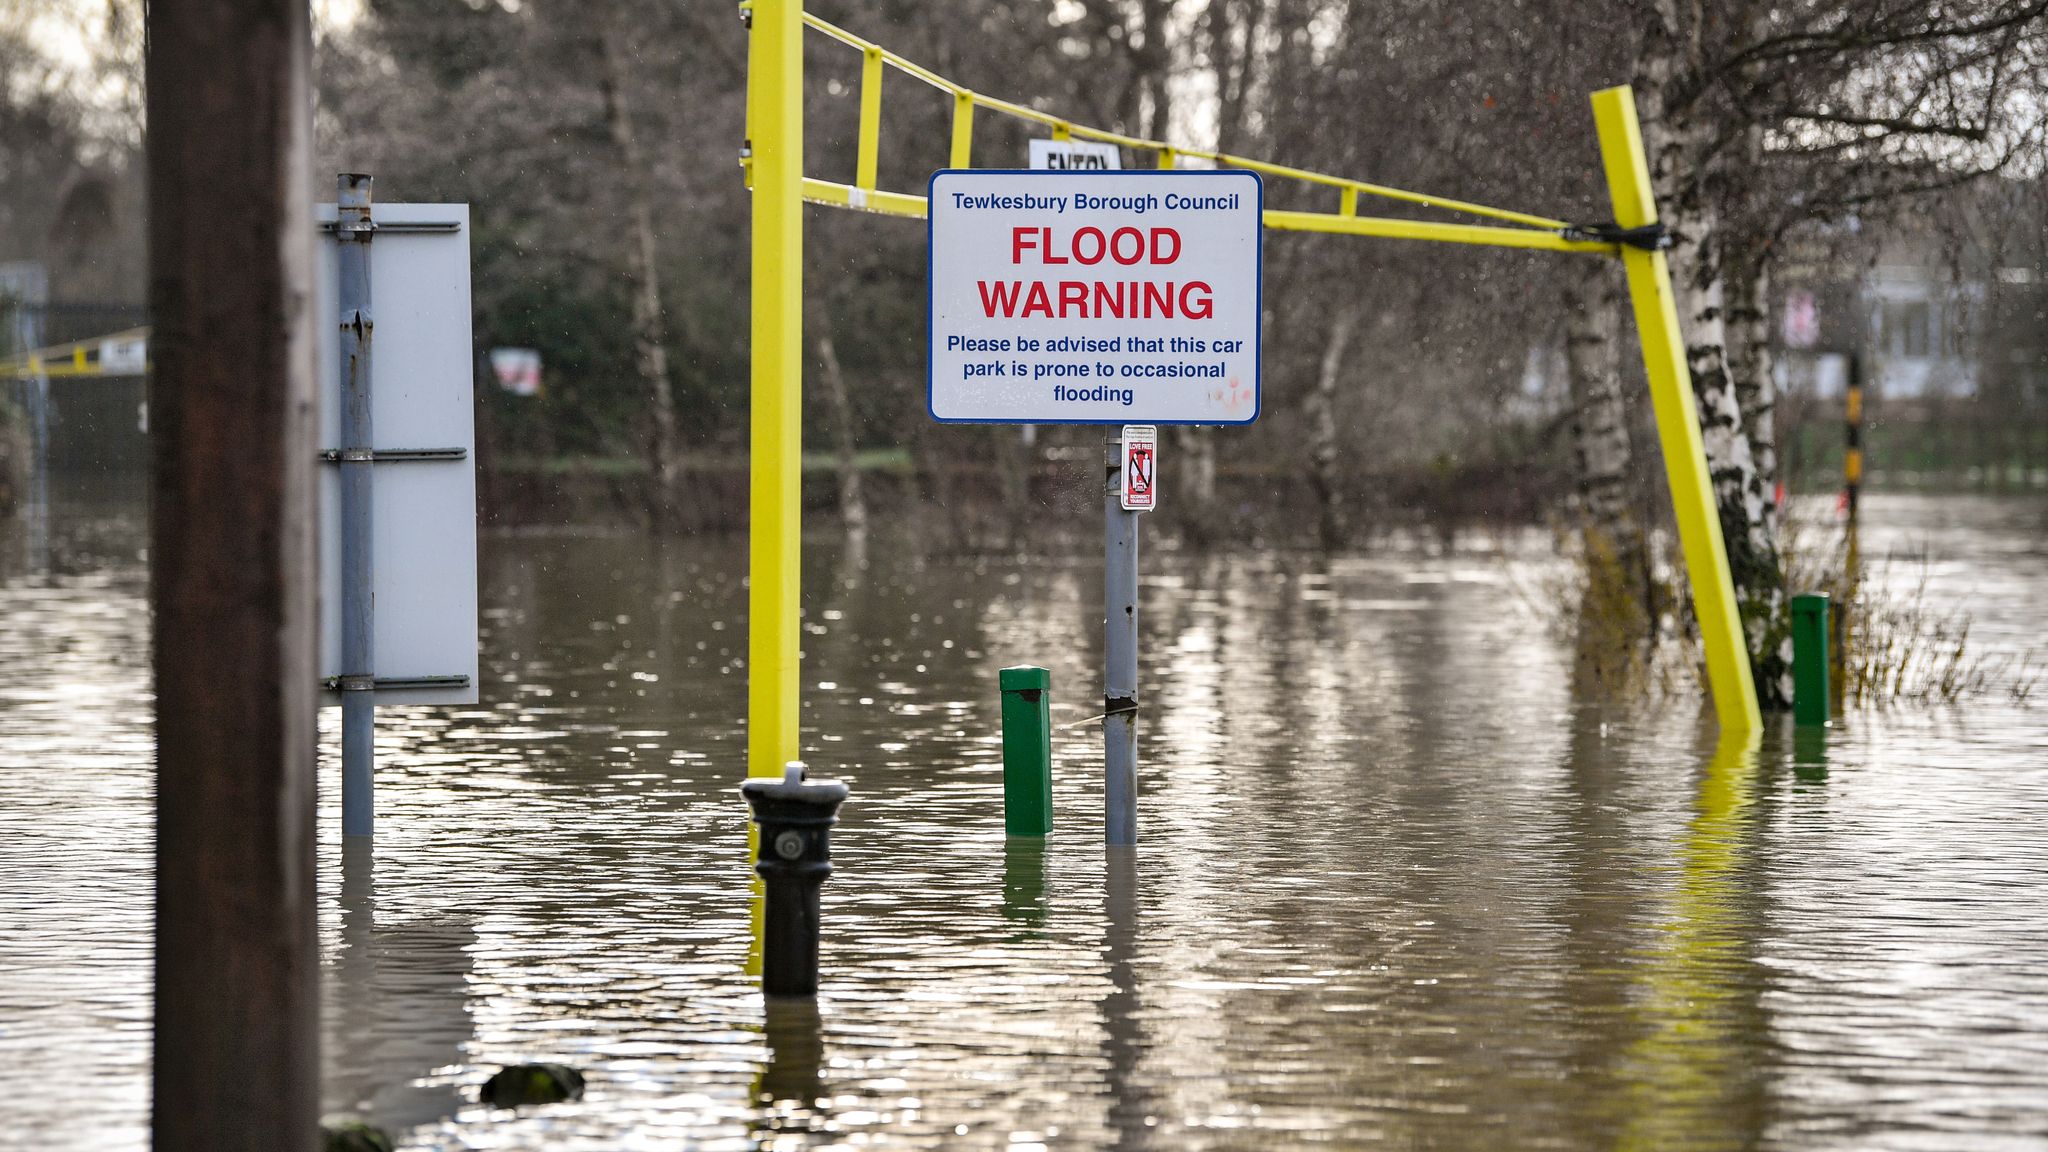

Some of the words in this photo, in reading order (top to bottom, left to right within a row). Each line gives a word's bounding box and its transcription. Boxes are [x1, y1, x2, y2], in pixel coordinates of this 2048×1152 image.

[952, 193, 1067, 214] Tewkesbury
[1075, 193, 1158, 214] Borough
[1165, 193, 1239, 210] Council
[1012, 226, 1182, 266] FLOOD
[977, 280, 1214, 320] WARNING
[948, 335, 1011, 352] Please
[1018, 335, 1040, 352] be
[1046, 336, 1121, 353] advised
[1127, 336, 1165, 353] that
[1170, 336, 1206, 353] this
[1213, 340, 1243, 353] car
[963, 360, 1006, 380] park
[1012, 360, 1028, 377] is
[1034, 364, 1090, 381] prone
[1096, 362, 1115, 377] to
[1121, 361, 1226, 378] occasional
[1053, 384, 1133, 406] flooding
